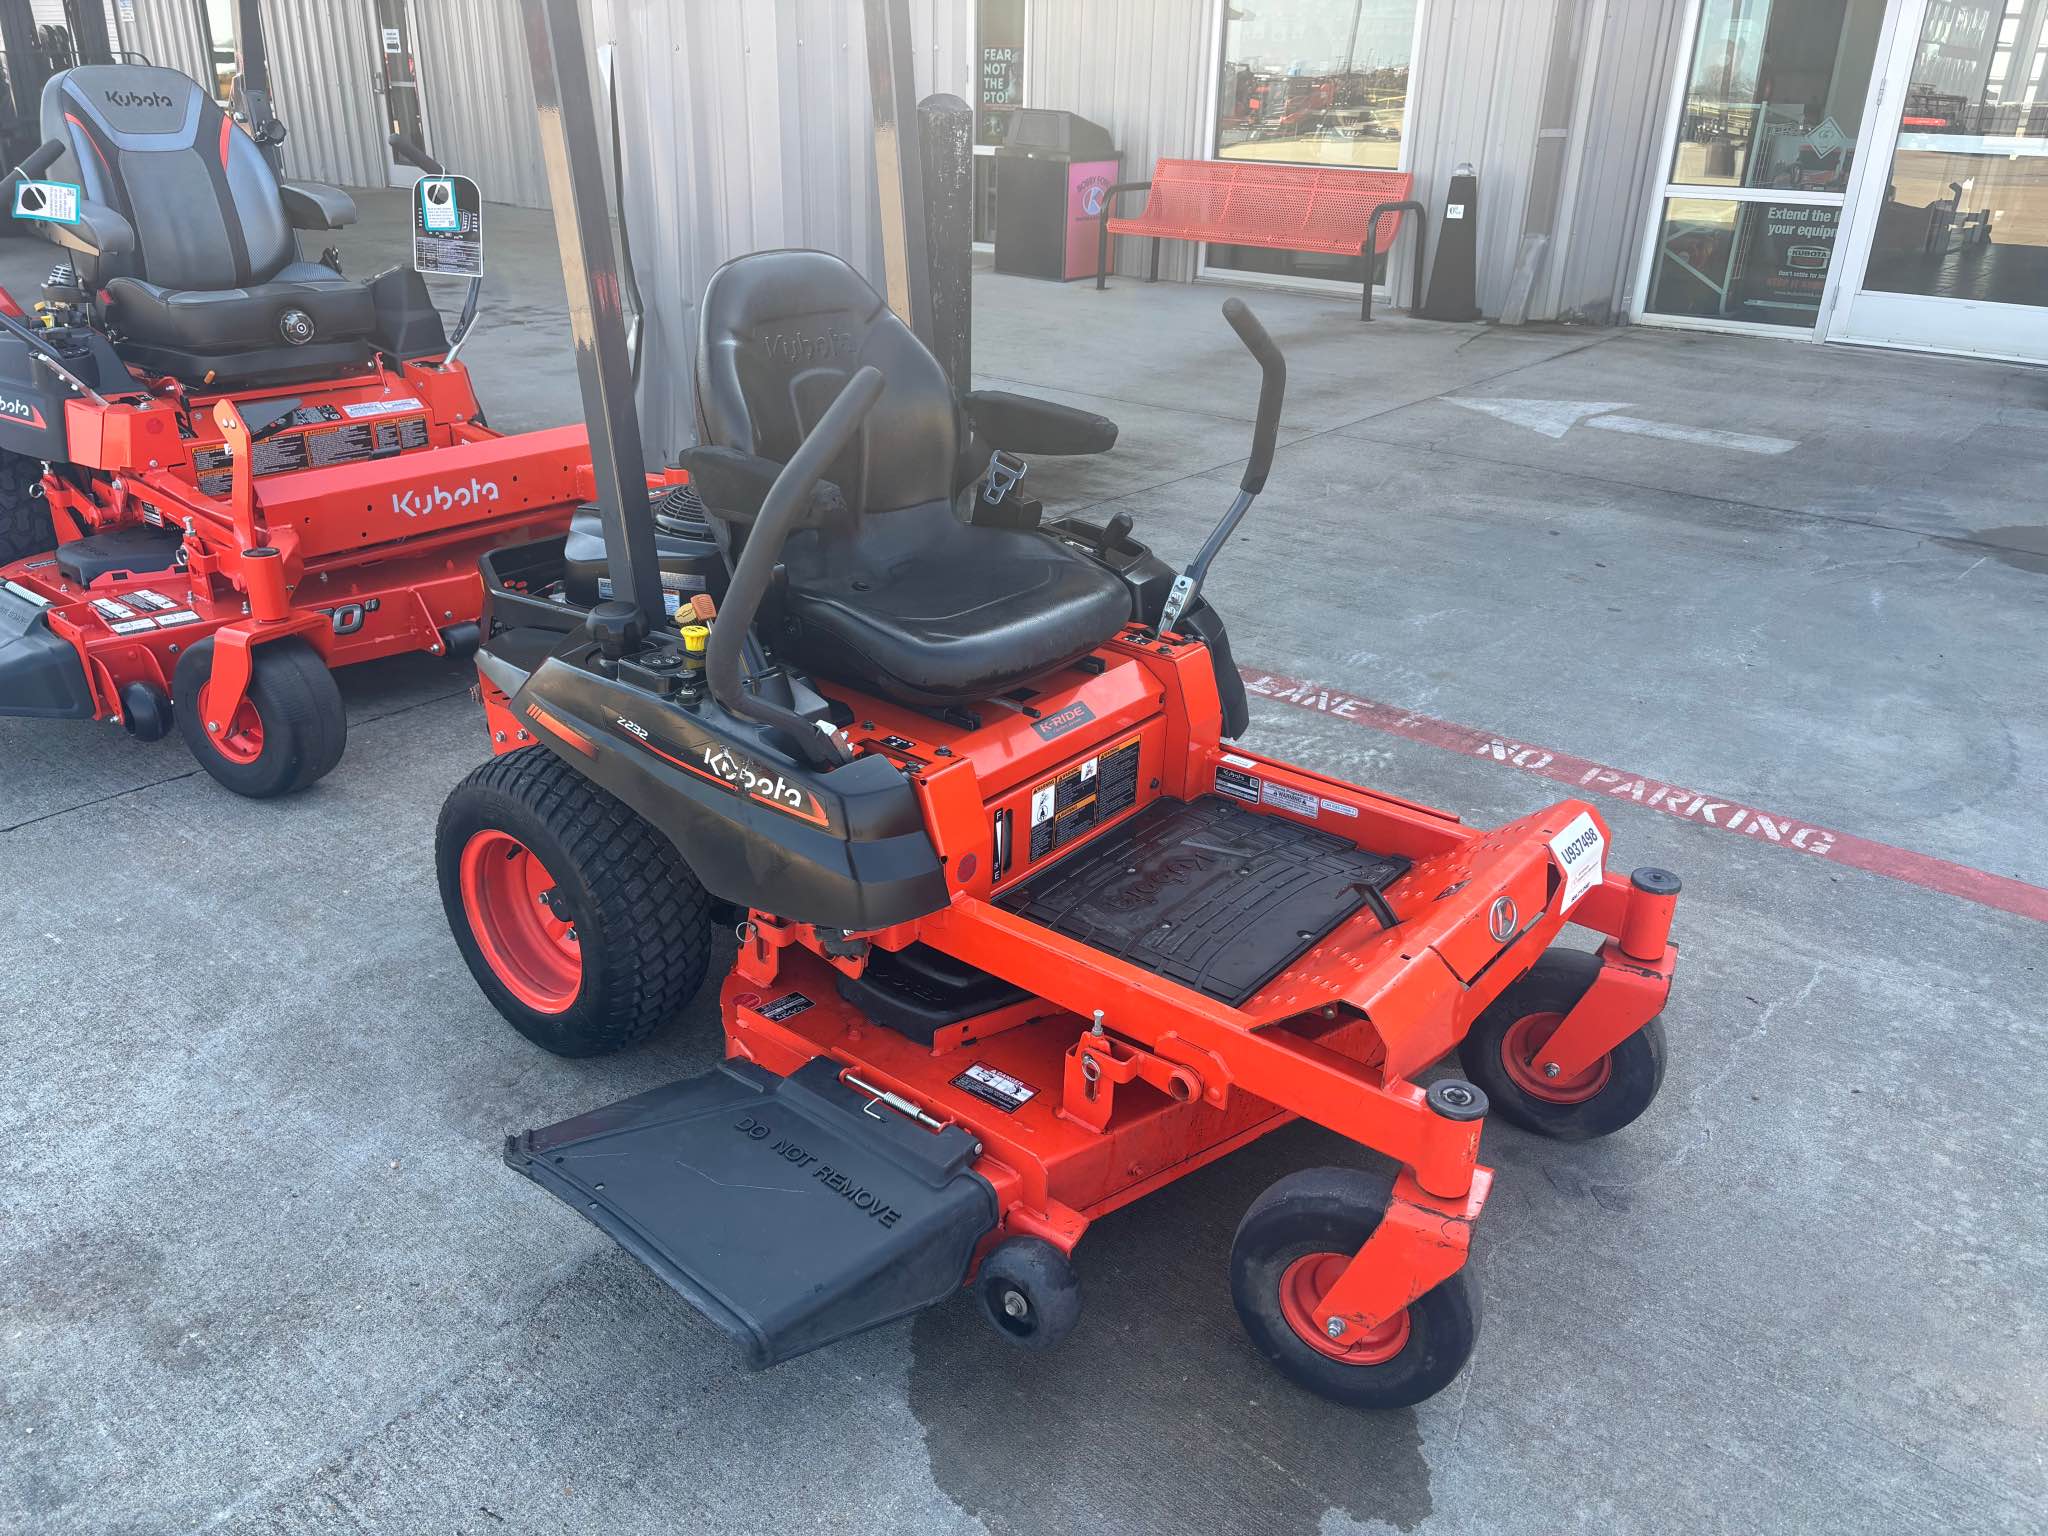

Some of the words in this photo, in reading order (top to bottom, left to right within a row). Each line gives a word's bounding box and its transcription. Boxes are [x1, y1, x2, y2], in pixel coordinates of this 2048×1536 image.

[984, 48, 1012, 61] FEAR
[984, 63, 1007, 75] NOT
[984, 77, 1003, 89] THE
[105, 90, 173, 108] Kubota
[984, 91, 1009, 104] PTO!
[1768, 207, 1810, 221] Extend
[1811, 209, 1831, 222] the
[1768, 224, 1796, 237] your
[1792, 249, 1828, 258] KUBOTA
[0, 395, 29, 416] bota
[392, 478, 499, 518] Kubota
[616, 715, 649, 741] Z232
[1040, 706, 1085, 733] K-RIDE
[1245, 675, 1374, 718] LANE
[1476, 737, 1553, 770] NO
[1579, 766, 1836, 854] PARKING
[704, 745, 802, 808] Kubota
[1561, 827, 1598, 865] U937498
[734, 1116, 771, 1141] DO
[771, 1136, 817, 1169] NOT
[812, 1162, 902, 1229] REMOVE
